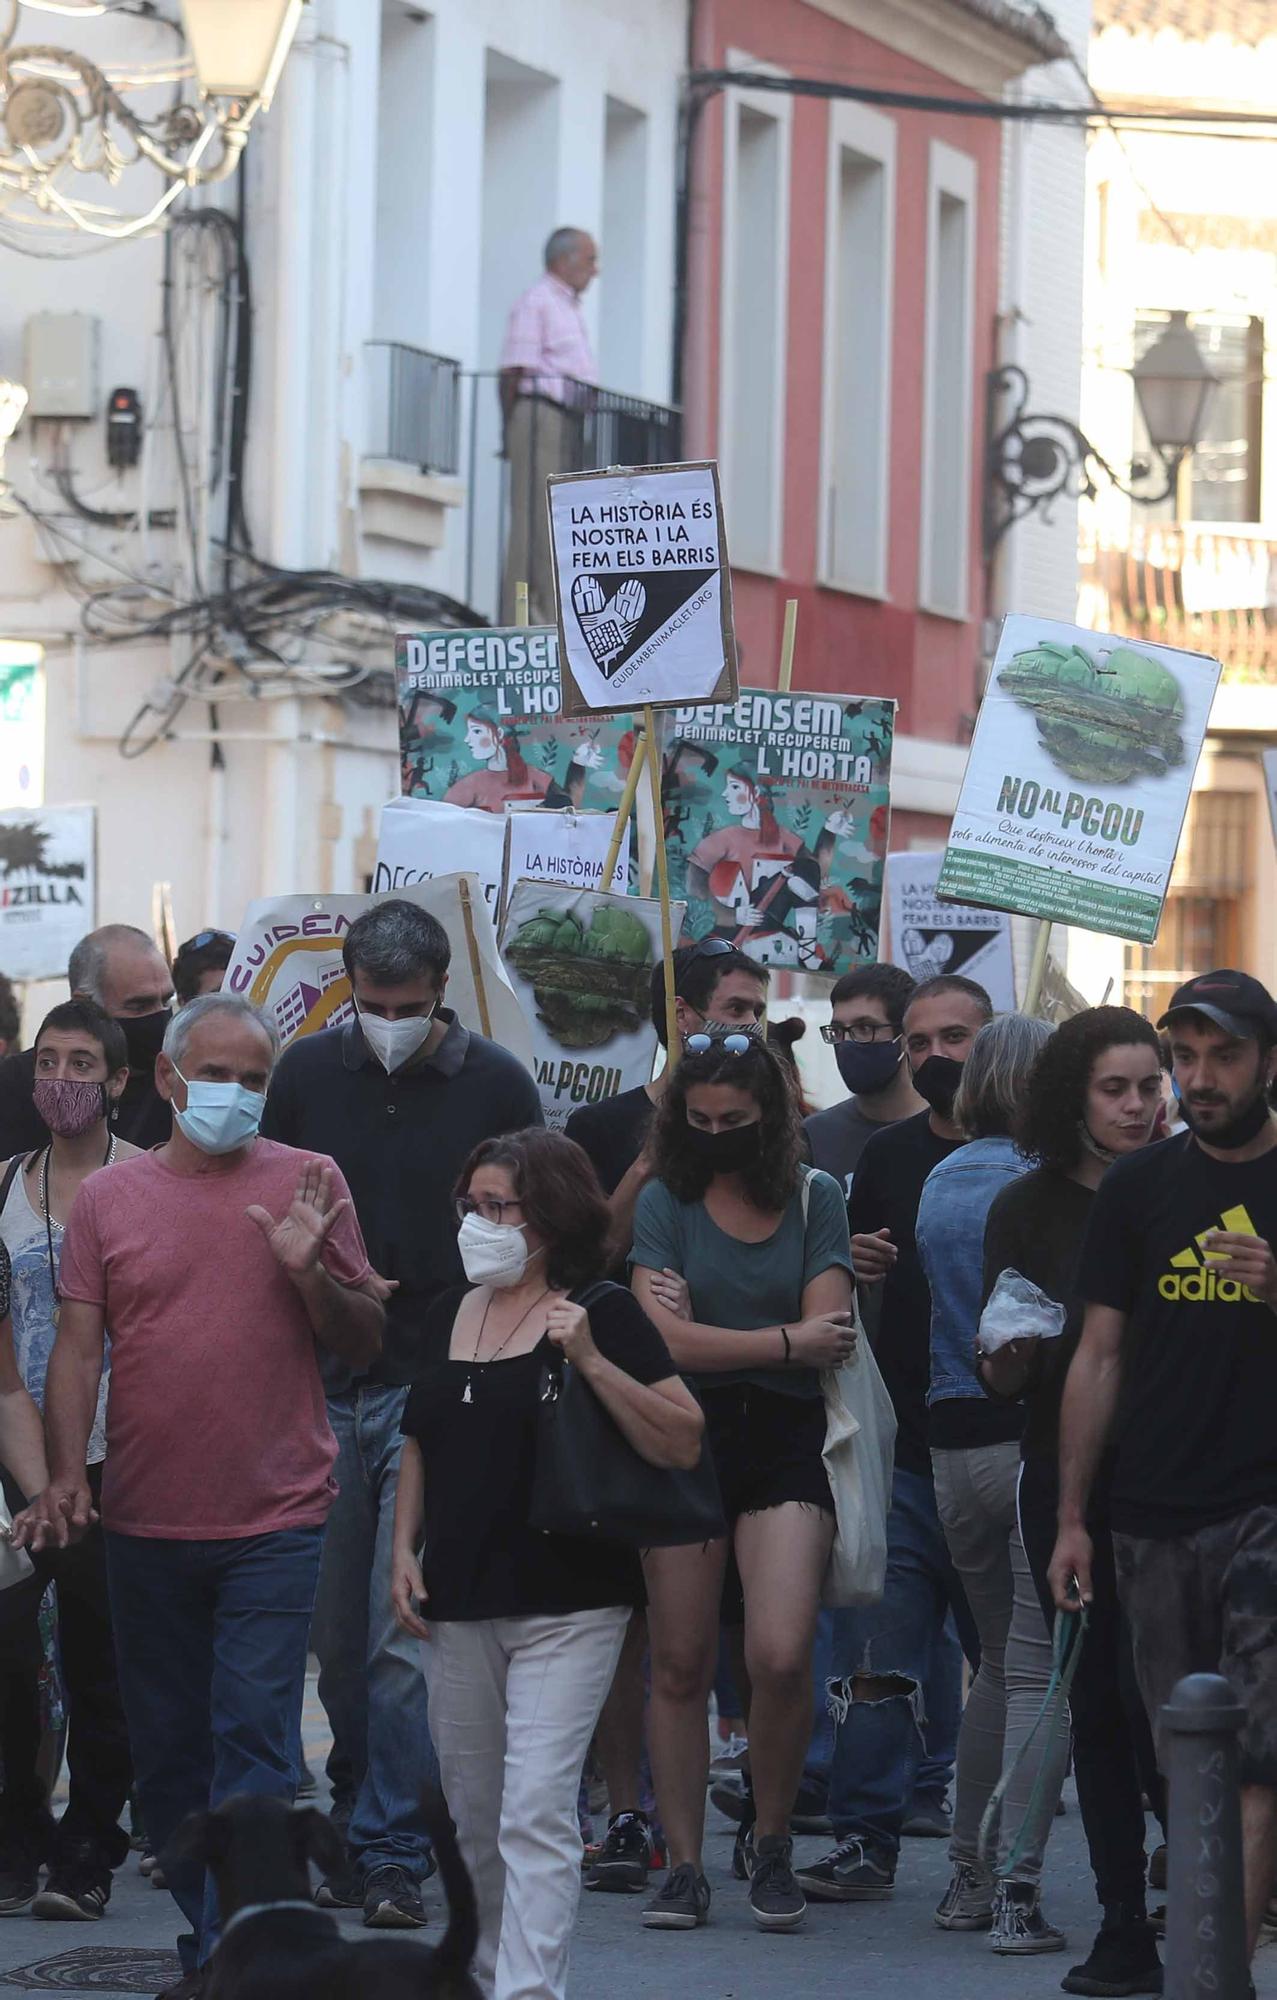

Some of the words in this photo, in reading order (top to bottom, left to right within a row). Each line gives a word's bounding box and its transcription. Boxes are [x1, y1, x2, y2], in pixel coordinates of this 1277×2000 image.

[571, 505, 594, 524] LA
[600, 500, 685, 523] HISTÒRIA
[692, 498, 713, 519] ÉS
[572, 527, 648, 546] NOSTRA
[656, 527, 661, 542] I
[668, 525, 689, 543] LA
[573, 551, 611, 568] FEM
[617, 550, 645, 567] ELS
[653, 547, 715, 565] BARRIS
[612, 589, 713, 689] CUIDEMBENIMACLET.ORG
[757, 747, 872, 784] L'HORTA
[997, 775, 1041, 820] NO
[1040, 788, 1063, 815] AL
[1061, 791, 1145, 846] PGOU
[998, 819, 1023, 836] Que
[1026, 827, 1075, 849] destrueix
[952, 827, 973, 841] sols
[975, 831, 1026, 852] alimenta
[1028, 843, 1045, 857] els
[1047, 850, 1098, 871] interessos
[1101, 861, 1119, 876] del
[526, 853, 543, 871] LA
[548, 856, 604, 877] HISTÒRIA
[903, 914, 928, 925] FEM
[932, 914, 952, 926] ELS
[957, 915, 1001, 927] BARRIS
[537, 1061, 555, 1086] AL
